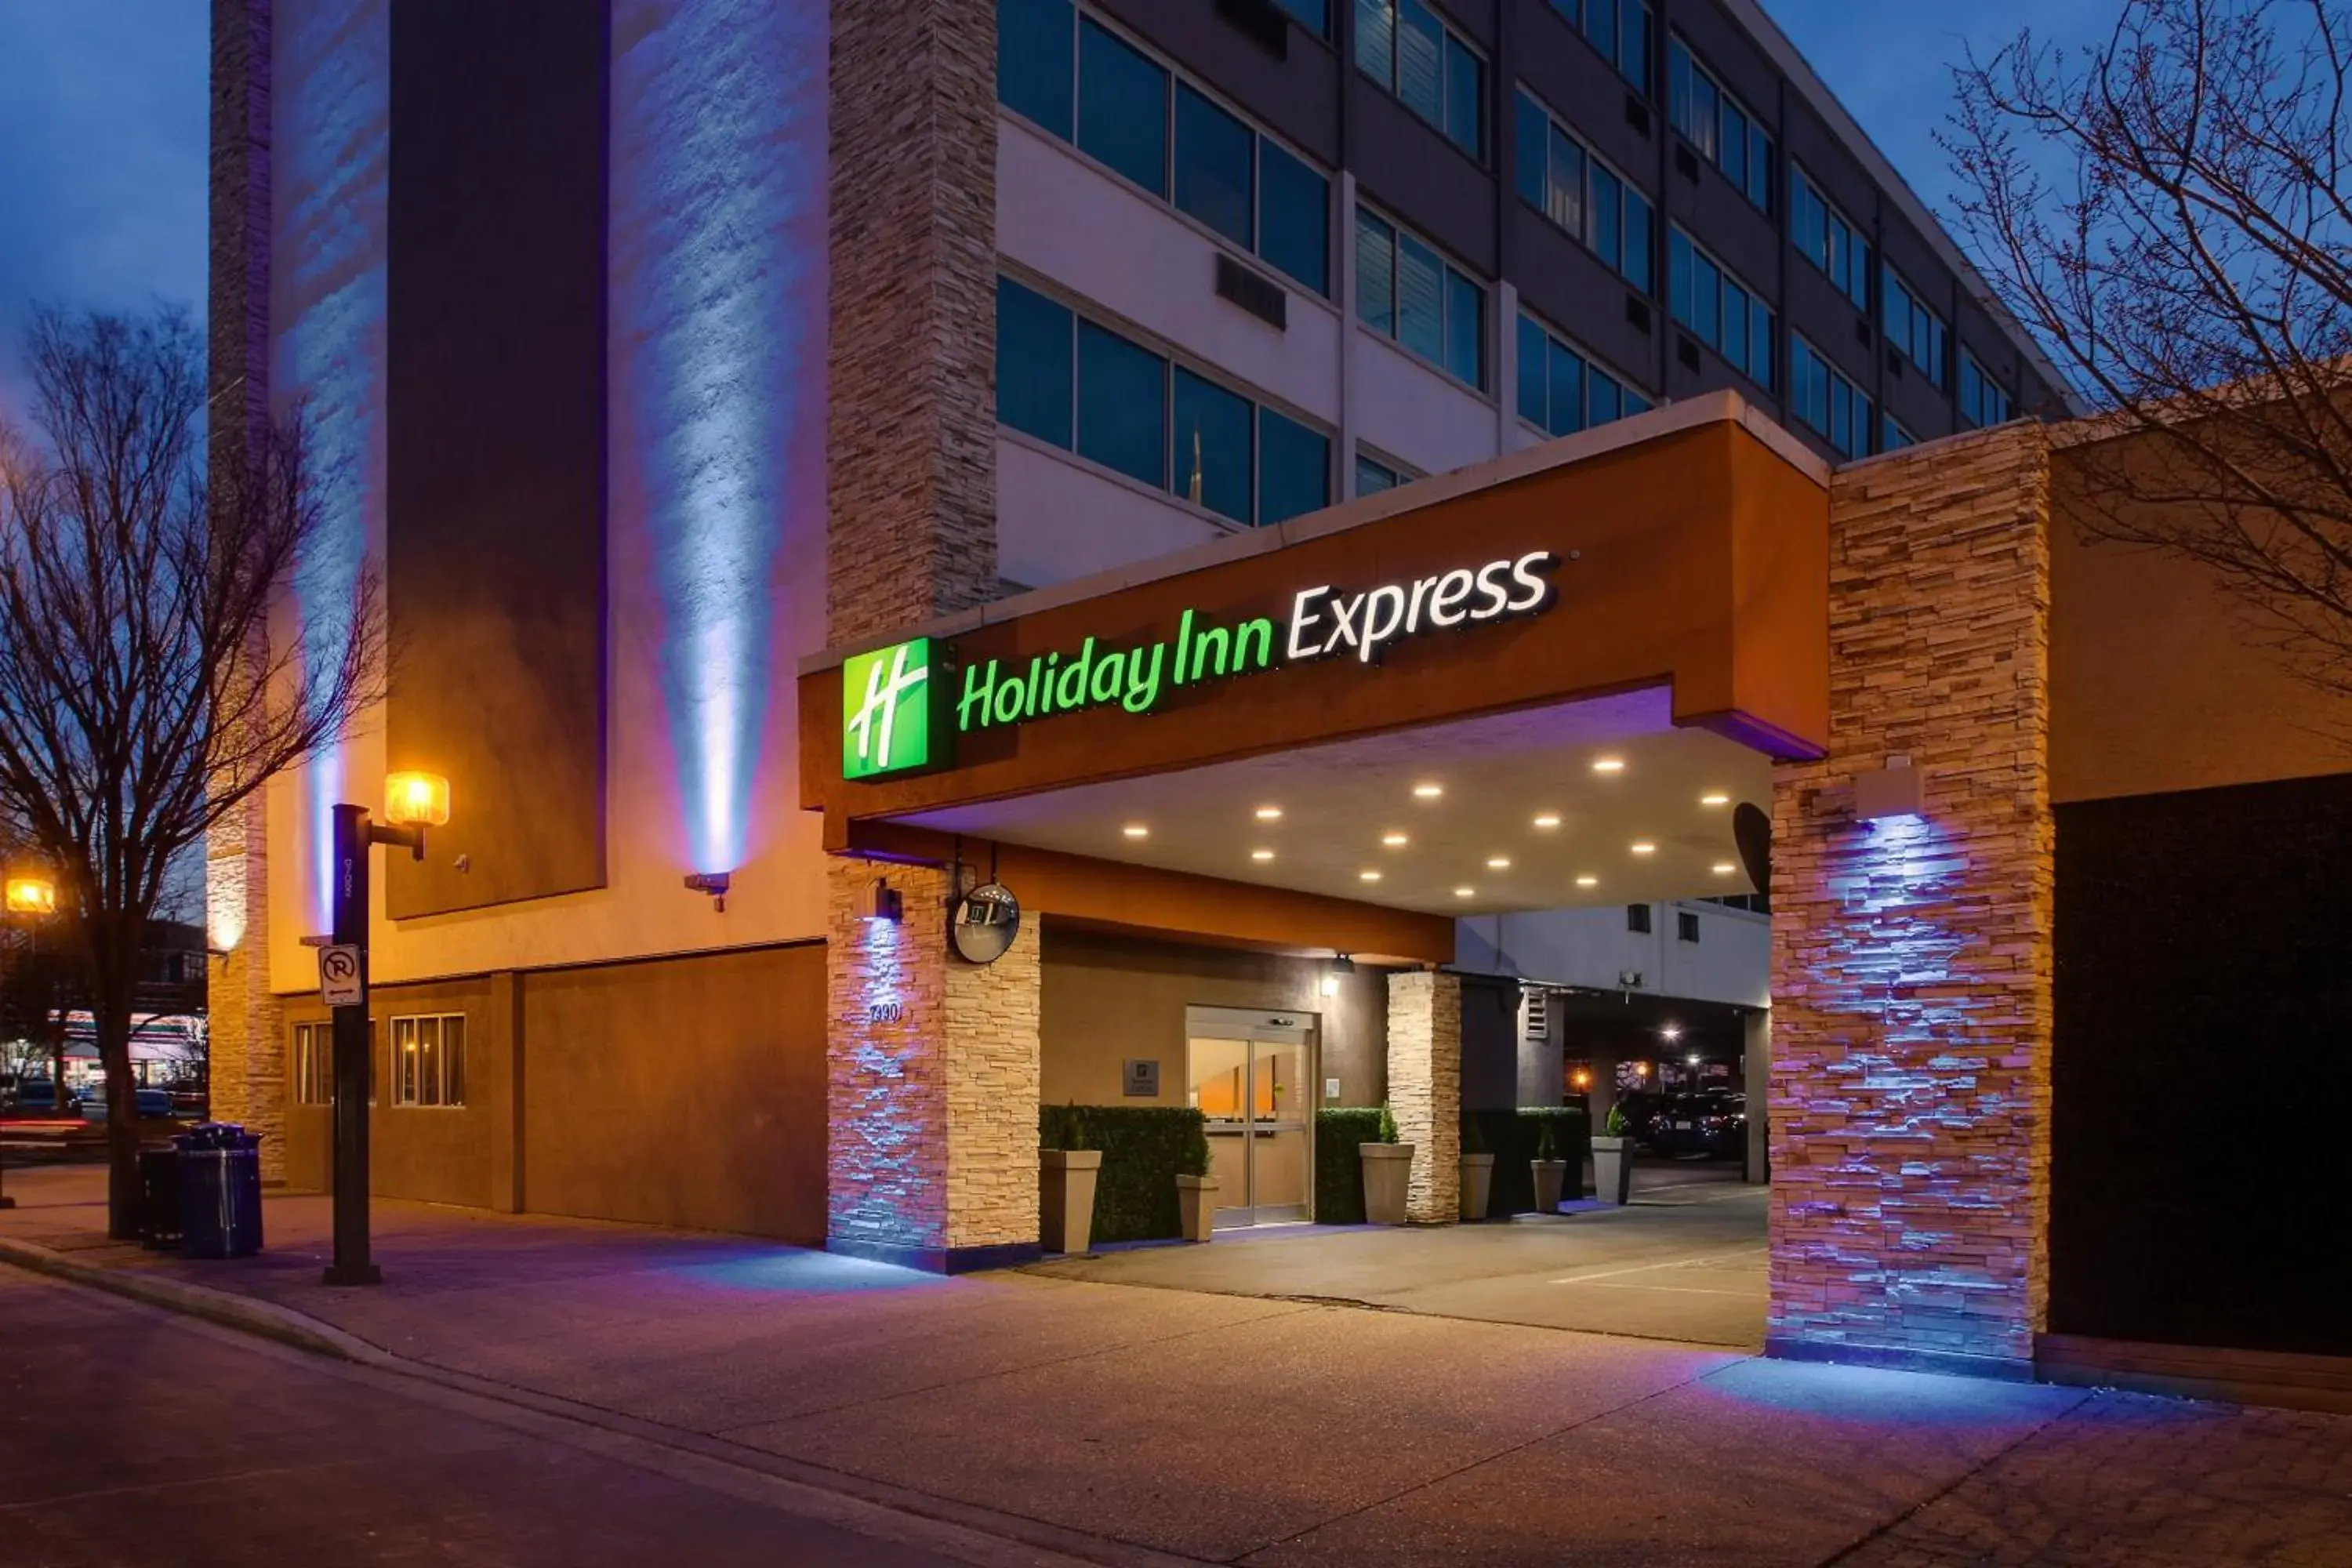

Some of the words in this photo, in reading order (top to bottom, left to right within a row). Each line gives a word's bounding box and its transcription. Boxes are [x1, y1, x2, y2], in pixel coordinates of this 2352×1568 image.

[956, 637, 1165, 731] Holiday
[1173, 608, 1272, 685] Inn
[1287, 550, 1549, 663] Express
